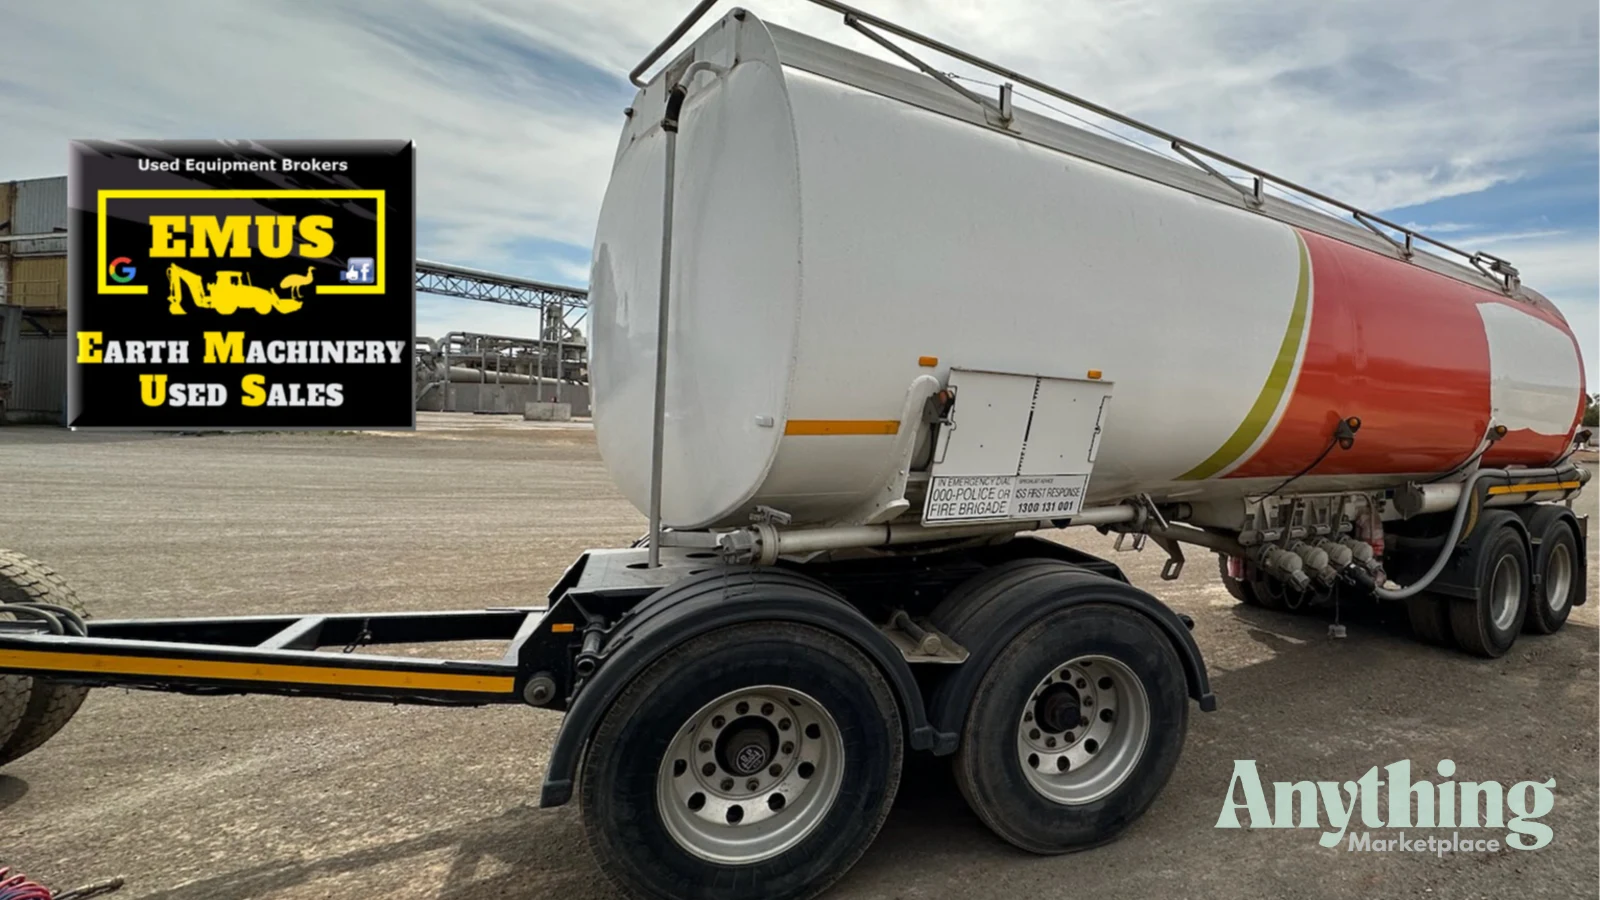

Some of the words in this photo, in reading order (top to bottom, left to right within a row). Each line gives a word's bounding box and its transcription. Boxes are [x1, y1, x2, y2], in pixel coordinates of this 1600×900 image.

[947, 477, 995, 486] EMERGENCY
[933, 487, 996, 501] 000-POLICE
[998, 489, 1011, 499] OR
[1027, 487, 1046, 498] FIRST
[1046, 487, 1081, 498] RESPONSE
[930, 503, 957, 516] FIRE
[958, 501, 1007, 515] BRIGADE
[1018, 502, 1040, 513] 1300
[1042, 501, 1056, 512] 131
[1057, 501, 1074, 511] 001
